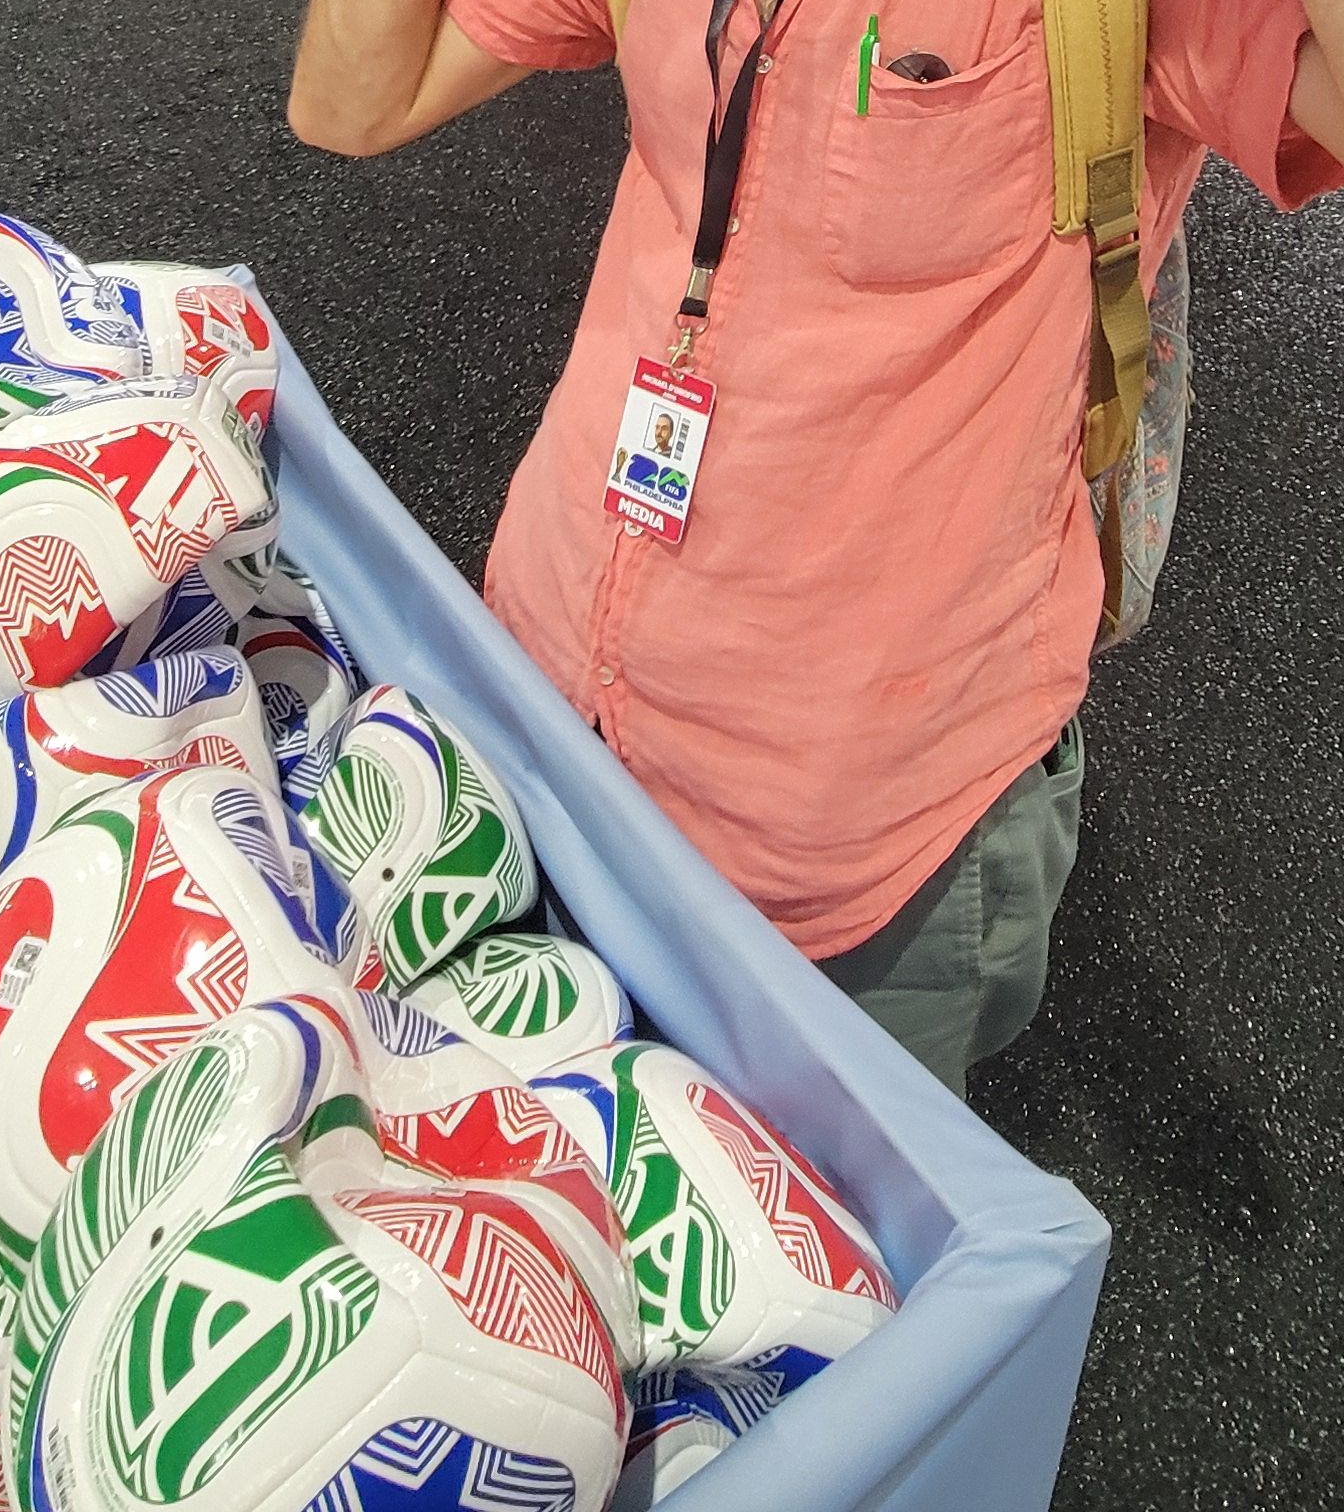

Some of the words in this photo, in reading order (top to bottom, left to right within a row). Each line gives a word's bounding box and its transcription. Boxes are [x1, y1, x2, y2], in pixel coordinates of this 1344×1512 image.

[623, 479, 684, 513] PHILADELPHIA
[664, 483, 681, 497] FIFA
[617, 496, 665, 533] MEDIA
